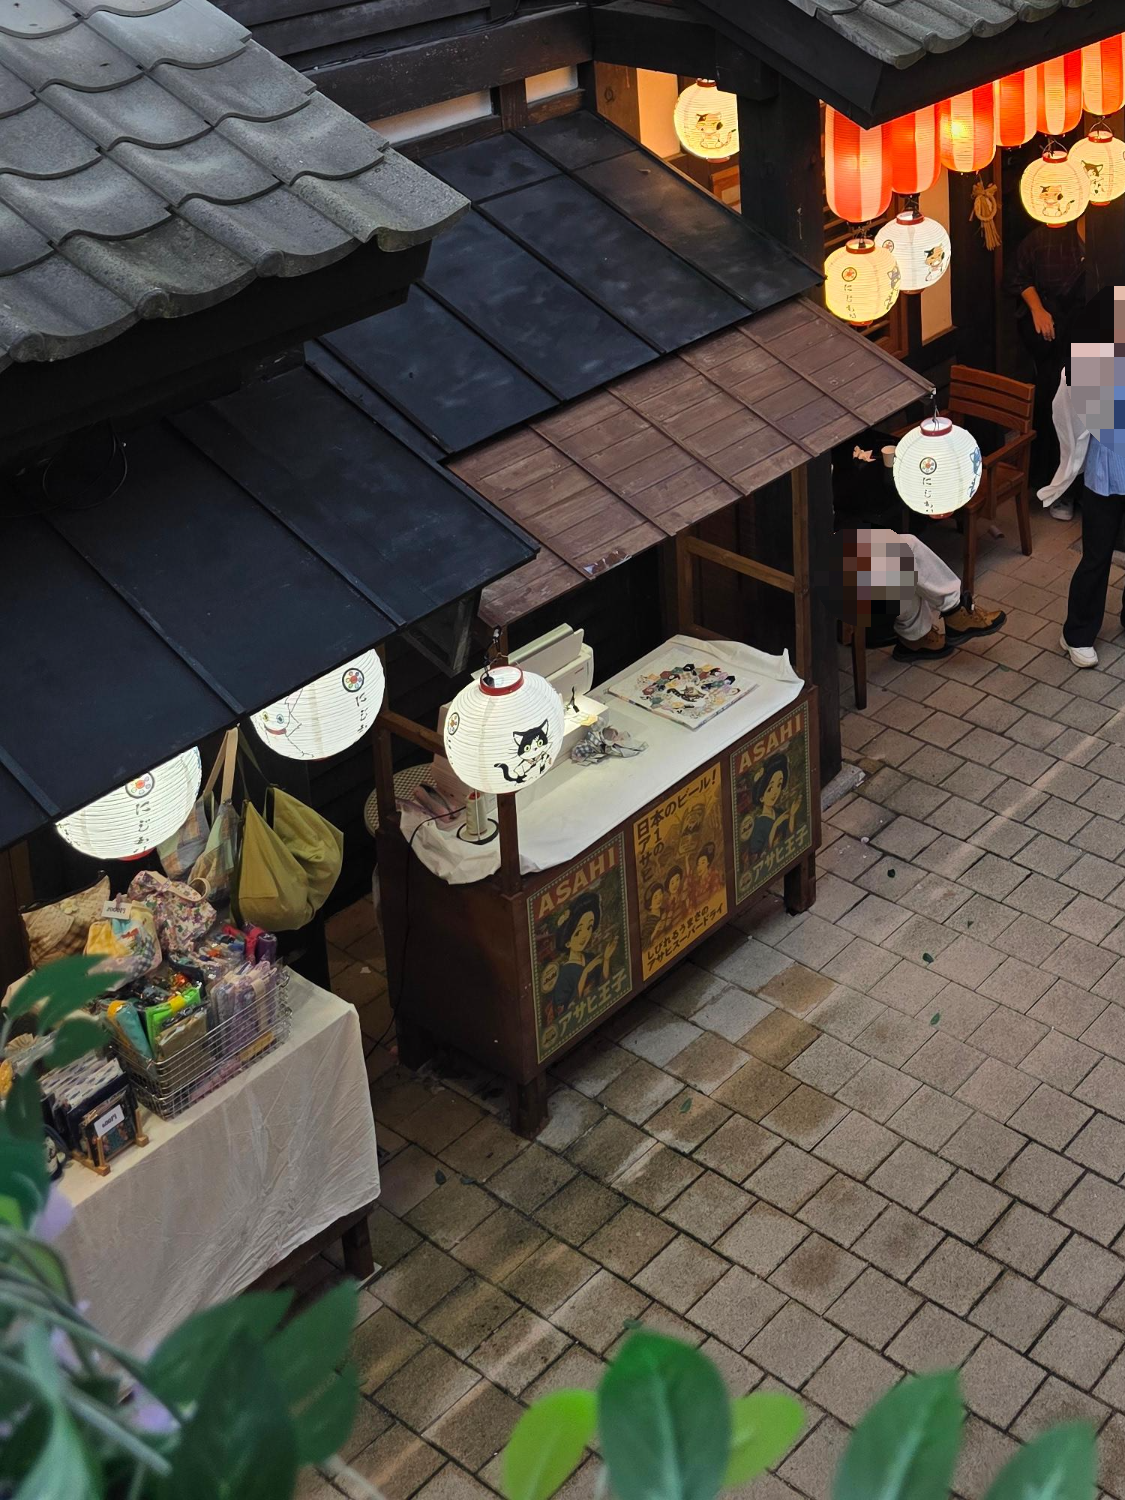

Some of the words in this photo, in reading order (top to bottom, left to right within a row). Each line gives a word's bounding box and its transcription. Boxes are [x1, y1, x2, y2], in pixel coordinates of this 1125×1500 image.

[738, 712, 802, 774] ASAHI
[538, 846, 615, 918] ASAHI
[753, 824, 809, 882] アサヒ王子
[558, 968, 628, 1038] アサヒ王子
